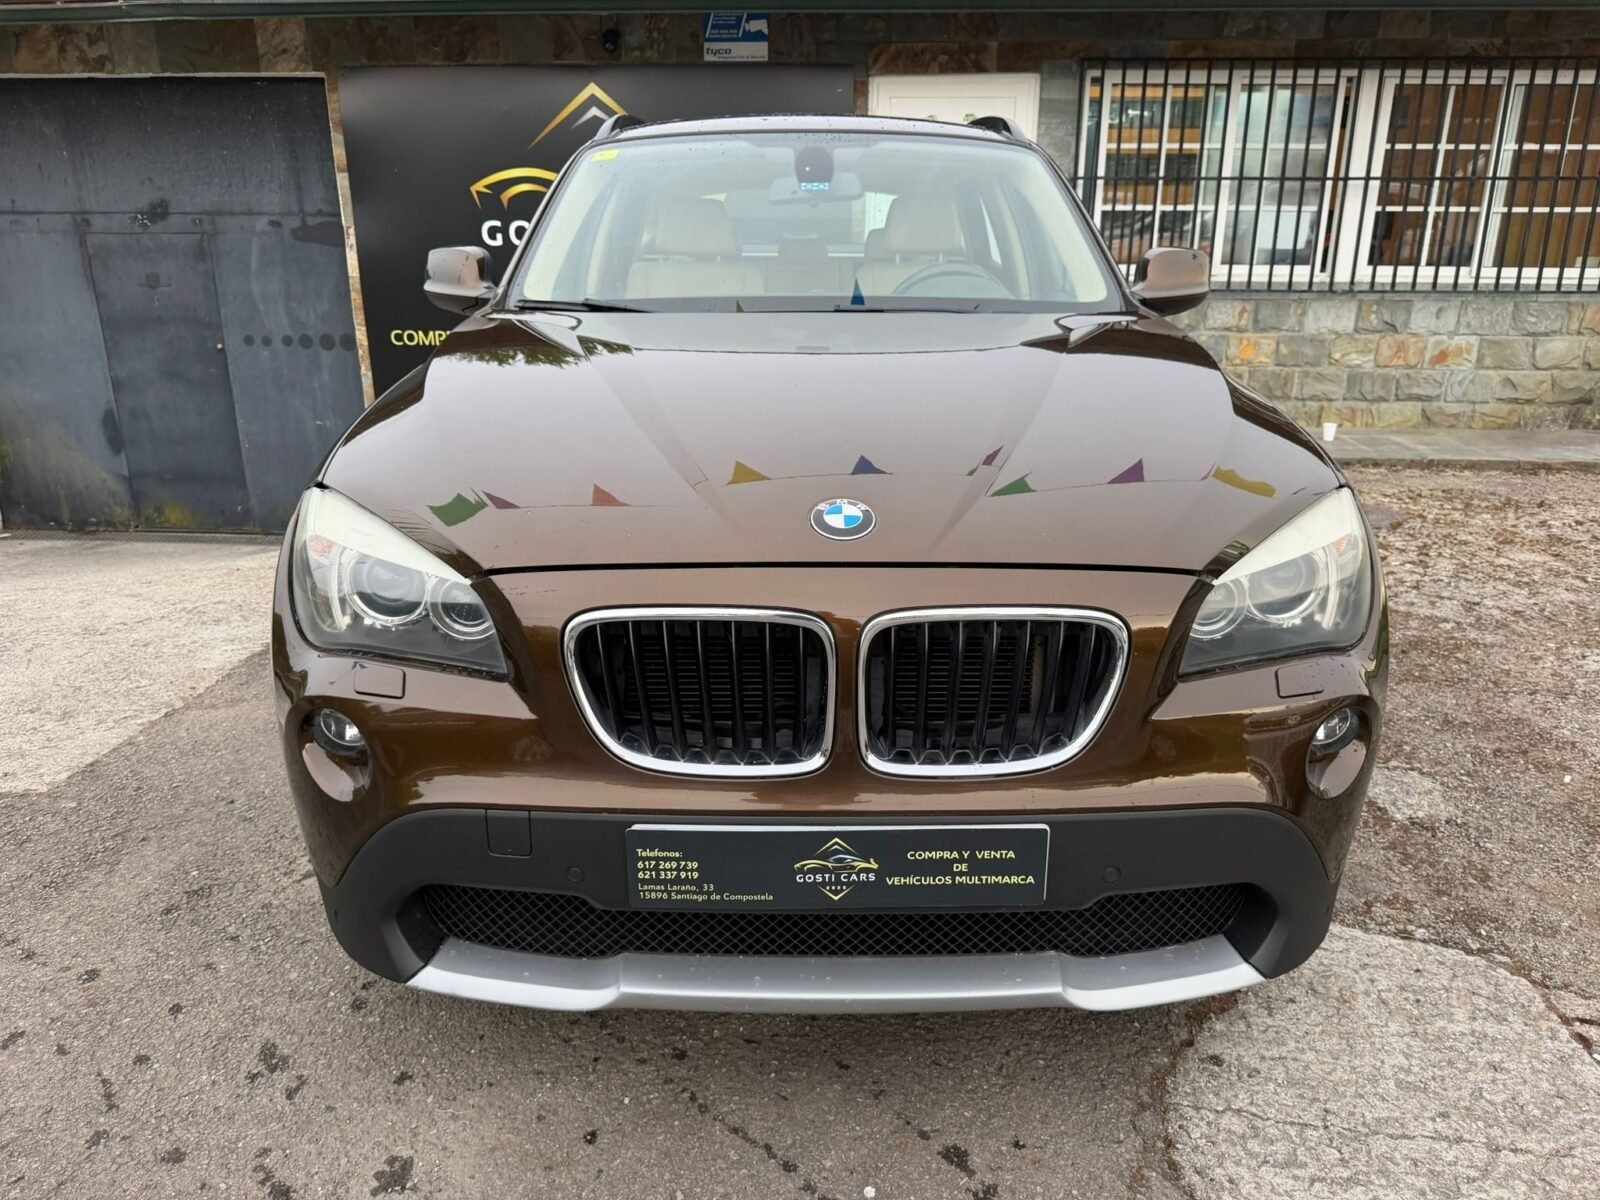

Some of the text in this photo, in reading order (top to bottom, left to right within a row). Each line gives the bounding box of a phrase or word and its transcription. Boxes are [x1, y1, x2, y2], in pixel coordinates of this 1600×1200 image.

[705, 47, 732, 56] tyco
[390, 329, 451, 346] COMP
[635, 848, 683, 857] Telefonos:
[907, 850, 1016, 860] COMPRA Y VENTA
[637, 861, 699, 870] 617 269 739
[953, 863, 969, 872] DE
[637, 870, 699, 879] 621 337 919
[796, 872, 877, 883] GOSTI CARS
[885, 875, 1035, 886] VEHÍCULOS MULTIMARCA
[638, 882, 665, 891] Lamas
[702, 883, 714, 892] 33
[640, 891, 774, 903] 15896 Santiago de Compostela
